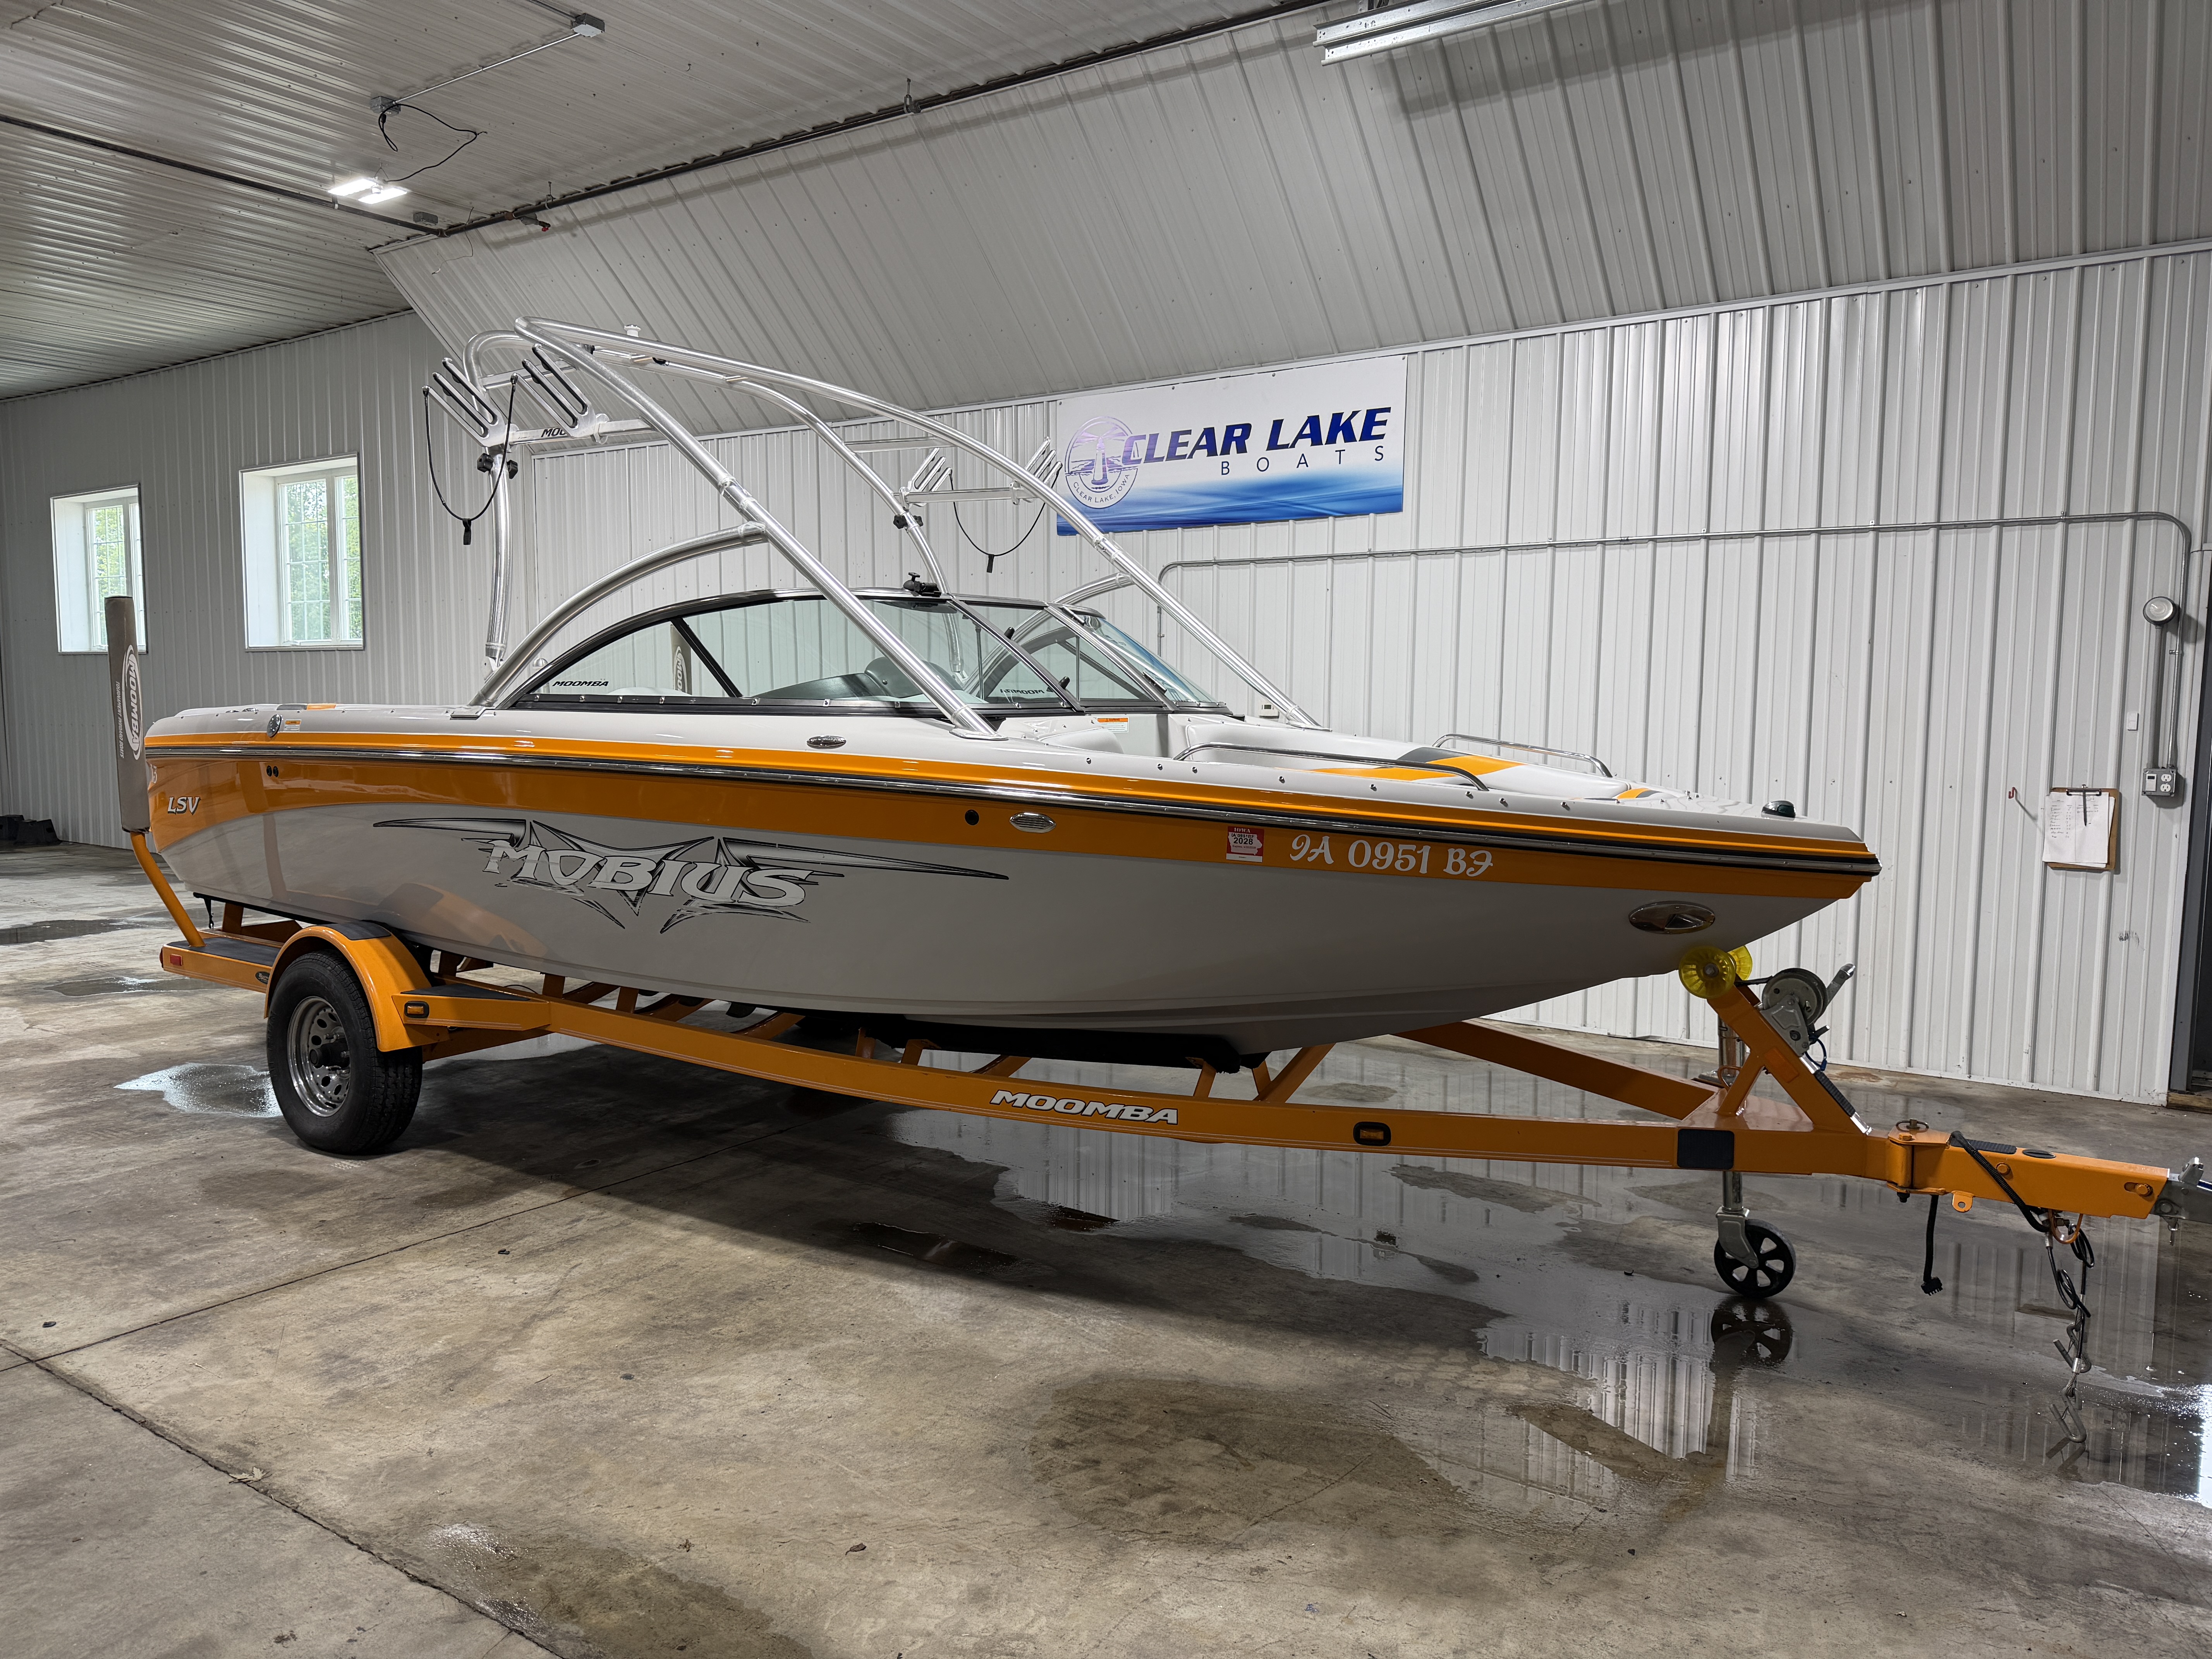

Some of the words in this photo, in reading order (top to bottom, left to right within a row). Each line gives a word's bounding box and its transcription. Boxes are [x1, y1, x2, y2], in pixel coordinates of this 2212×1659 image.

[1122, 423, 1252, 465] CLEAR
[1266, 407, 1391, 451] LAKE
[1221, 445, 1384, 476] BOATS
[1073, 482, 1092, 502] CLEAR
[1095, 494, 1116, 503] LAKE,
[1115, 474, 1130, 494] IOWA
[128, 659, 139, 744] MOOMBA
[168, 796, 201, 815] LSV
[482, 840, 816, 907] MOBIUS
[1348, 840, 1431, 874] 0951
[989, 1089, 1178, 1125] MOOMBA
